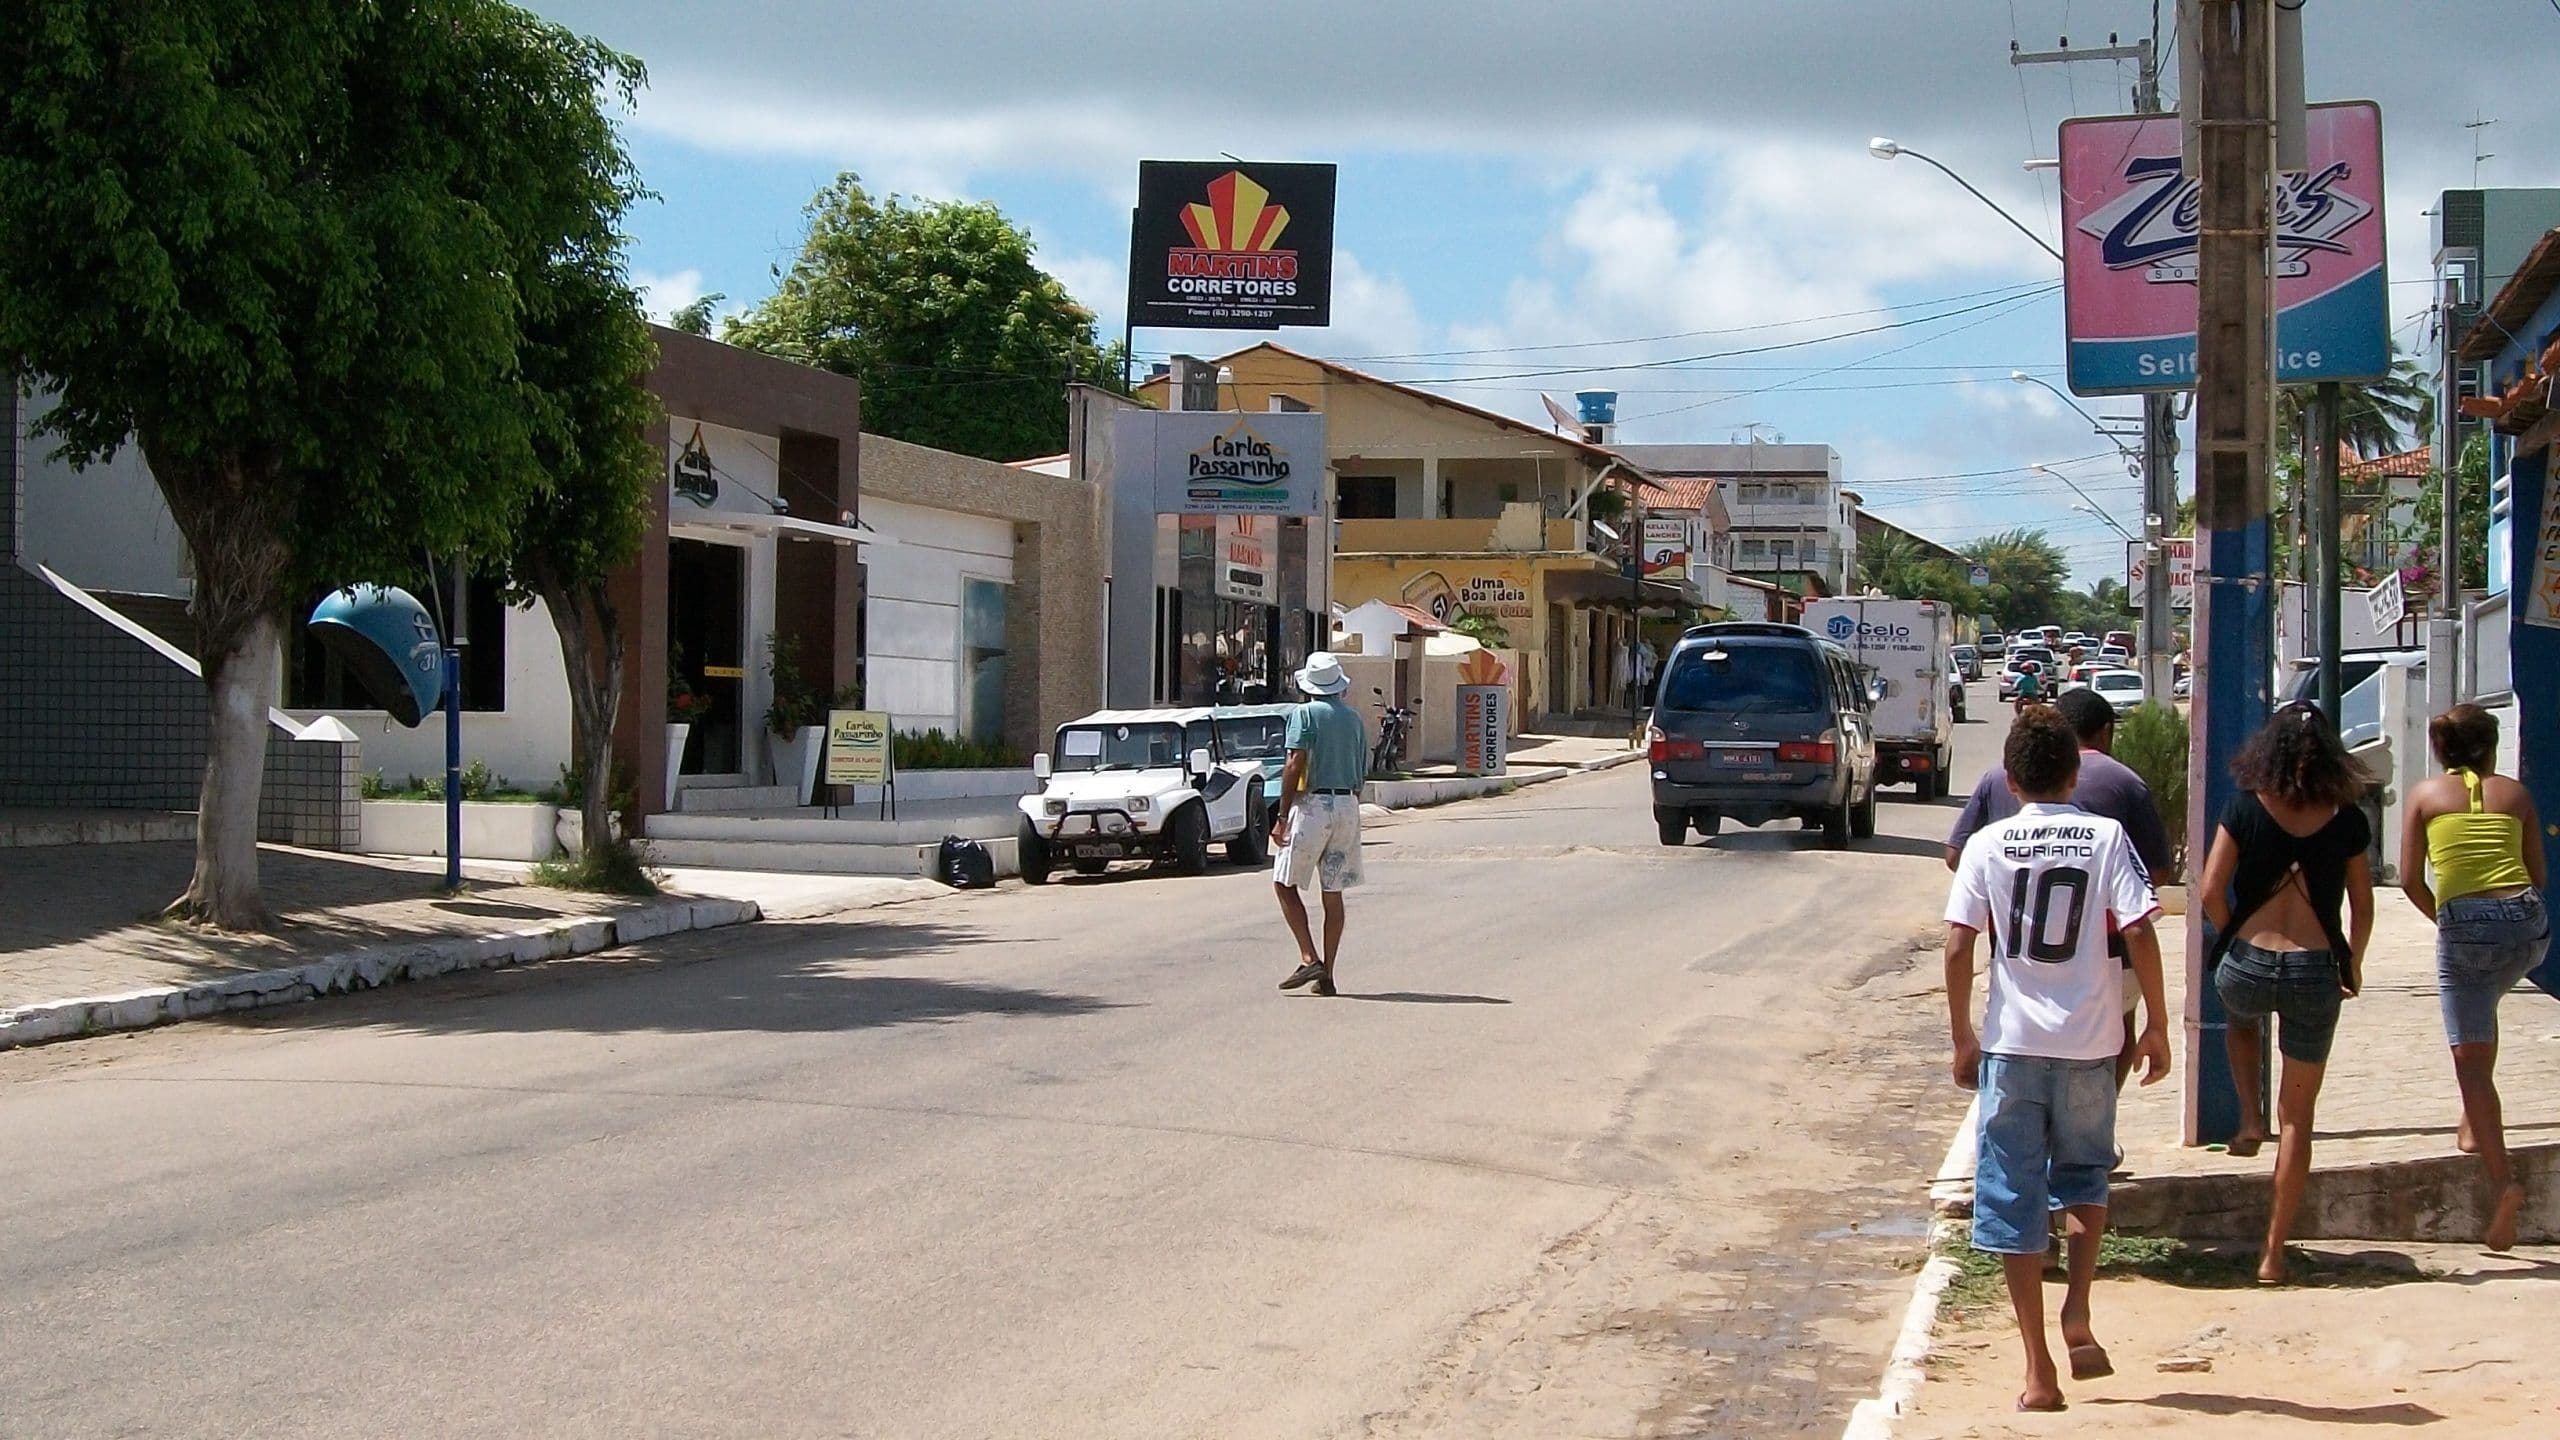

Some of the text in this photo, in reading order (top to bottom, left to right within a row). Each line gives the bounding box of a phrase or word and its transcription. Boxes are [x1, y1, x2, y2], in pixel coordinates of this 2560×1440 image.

[1168, 253, 1298, 280] MARTINS
[1167, 278, 1297, 296] CORRETORES
[1213, 435, 1271, 457] Carlos
[1189, 453, 1290, 477] Passarinho
[1472, 577, 1504, 589] Uma
[1462, 588, 1487, 602] Boa
[1856, 622, 1910, 636] Gelo
[846, 721, 874, 730] Carlos
[1465, 693, 1481, 769] MARTINS
[1486, 693, 1497, 769] CORRETORES
[2003, 826, 2096, 841] OLYMPIKUS
[2004, 845, 2093, 857] ADRIANO
[2006, 867, 2090, 963] 10
